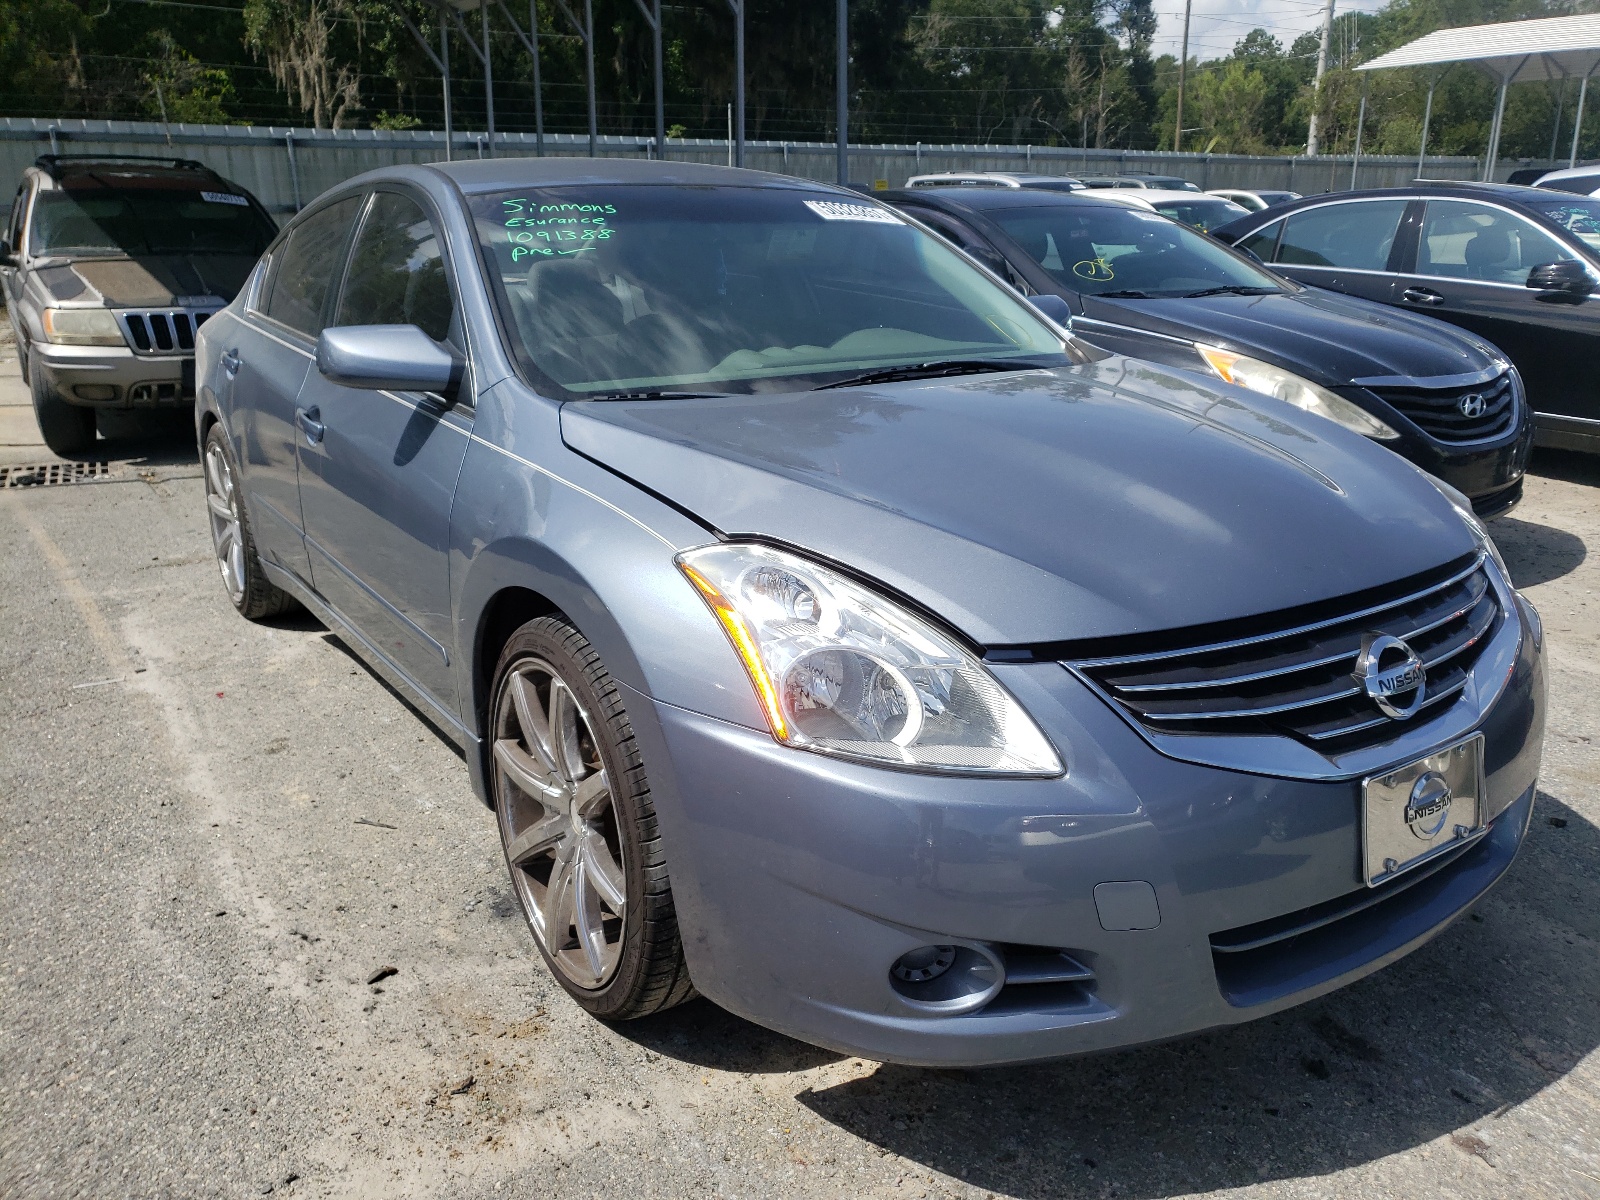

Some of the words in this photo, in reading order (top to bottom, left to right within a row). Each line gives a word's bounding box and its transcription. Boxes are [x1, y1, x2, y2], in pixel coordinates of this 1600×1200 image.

[502, 198, 617, 214] Simmons
[504, 217, 606, 227] Esurance
[506, 229, 616, 243] 1091388
[1378, 668, 1425, 693] NISSAN
[1413, 795, 1452, 820] NISSAN
